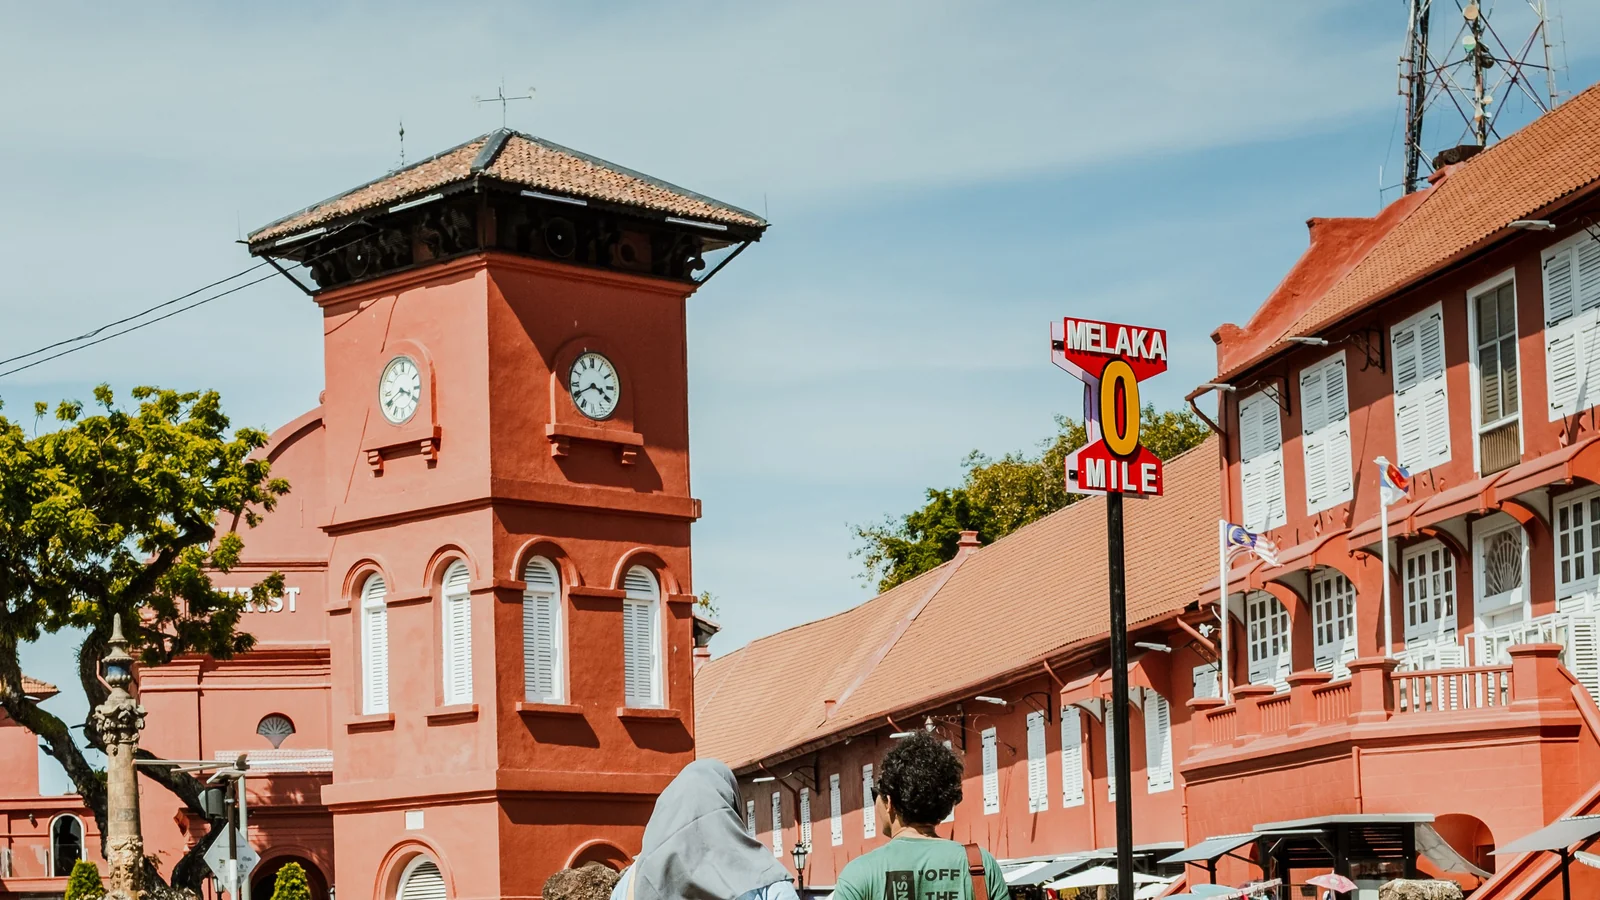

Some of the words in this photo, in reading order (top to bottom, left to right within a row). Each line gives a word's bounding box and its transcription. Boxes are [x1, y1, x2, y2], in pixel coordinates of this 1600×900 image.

[1067, 320, 1167, 361] MELAKA
[1101, 360, 1140, 455] 0
[1085, 457, 1158, 492] MILE
[925, 892, 959, 900] THE
